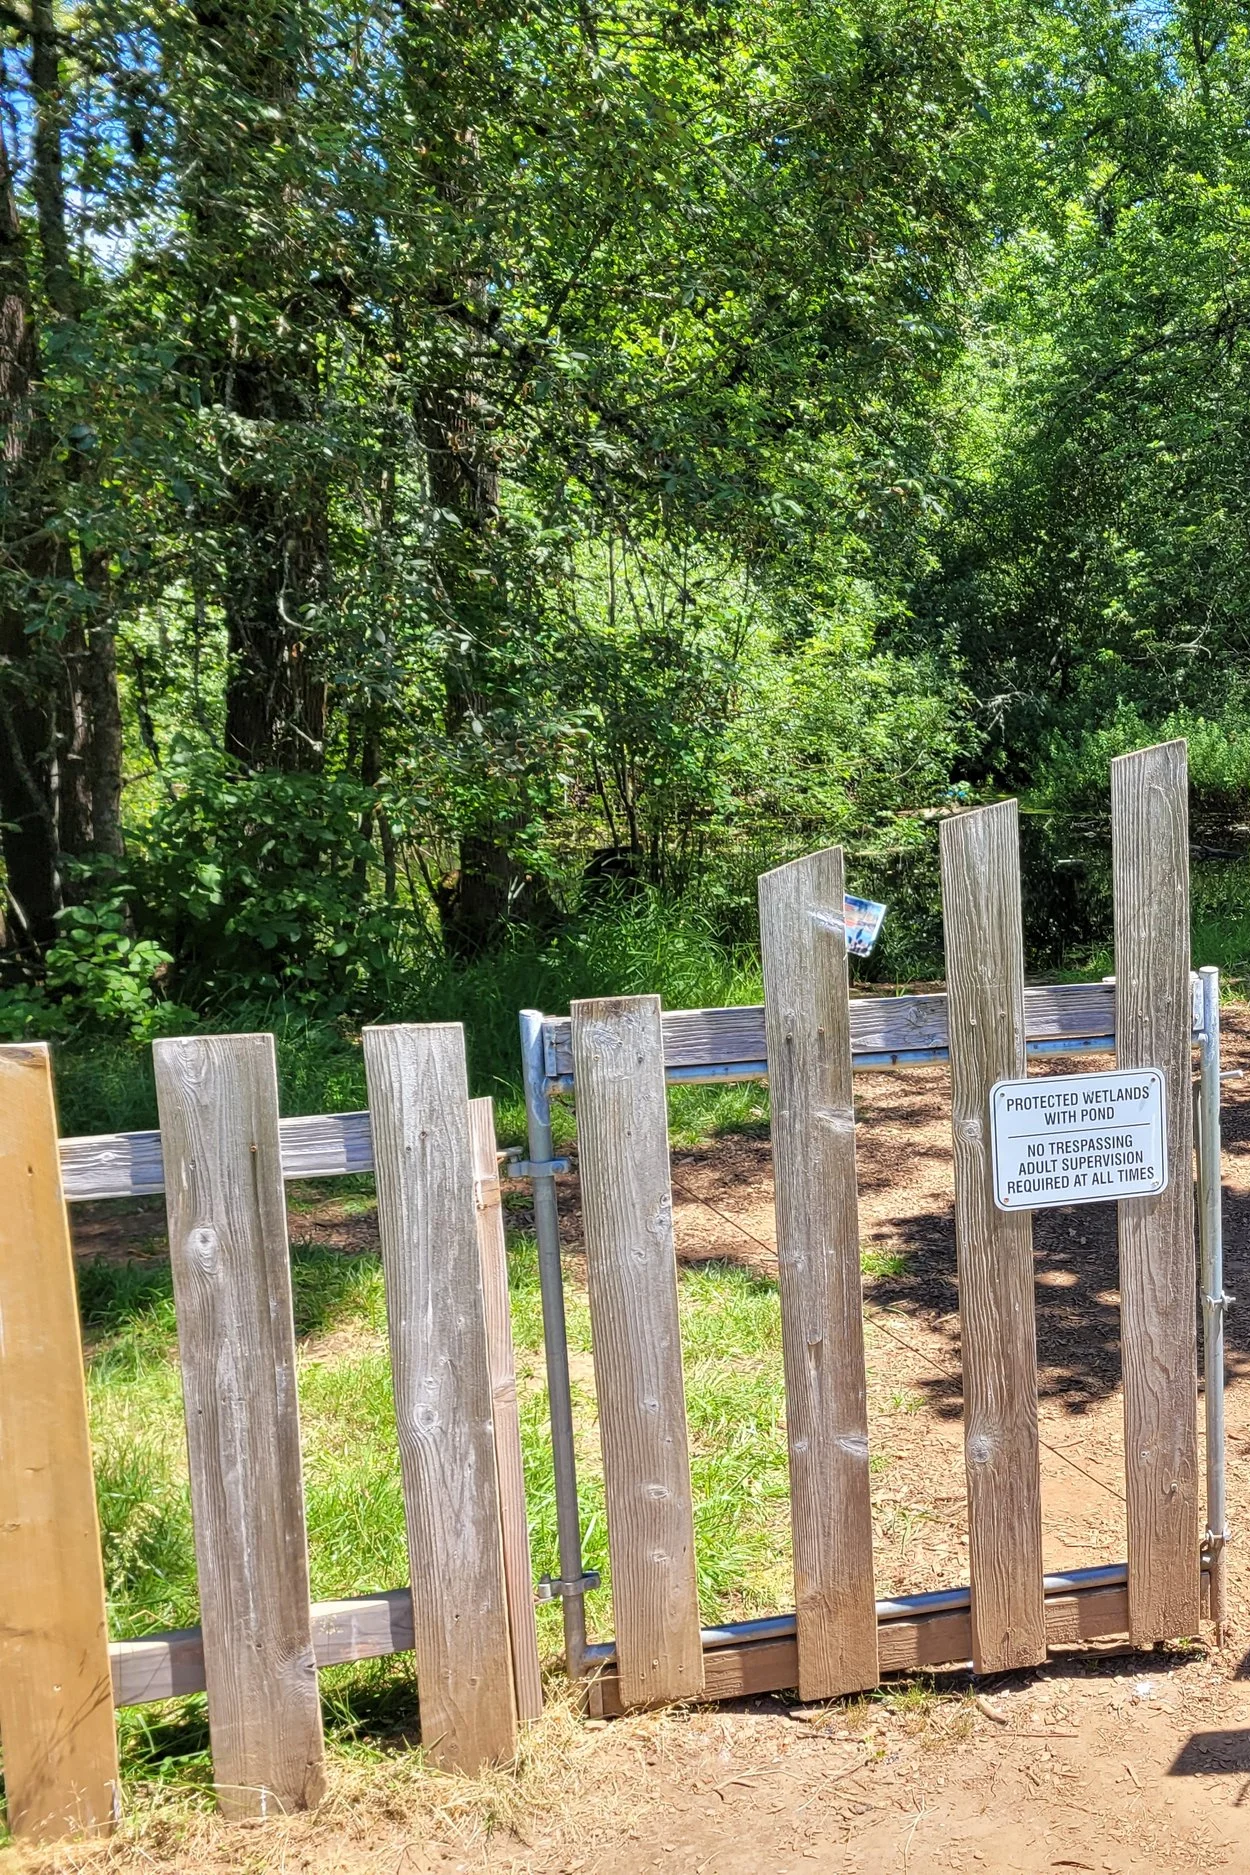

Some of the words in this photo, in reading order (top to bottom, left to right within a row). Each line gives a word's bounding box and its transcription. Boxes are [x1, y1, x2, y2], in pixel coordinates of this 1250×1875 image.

[1007, 1092, 1078, 1111] PROTECTED
[1083, 1086, 1149, 1104] WETLANDS
[1044, 1110, 1076, 1125] WITH
[1081, 1107, 1114, 1122] POND
[1028, 1144, 1044, 1157] NO
[1049, 1135, 1133, 1155] TRESPASSING
[1019, 1160, 1057, 1175] ADULT
[1062, 1151, 1143, 1171] SUPERVISION
[1008, 1175, 1069, 1194] REQUIRED
[1074, 1174, 1087, 1188] AT
[1092, 1171, 1113, 1185] ALL
[1118, 1167, 1154, 1182] TIMES
